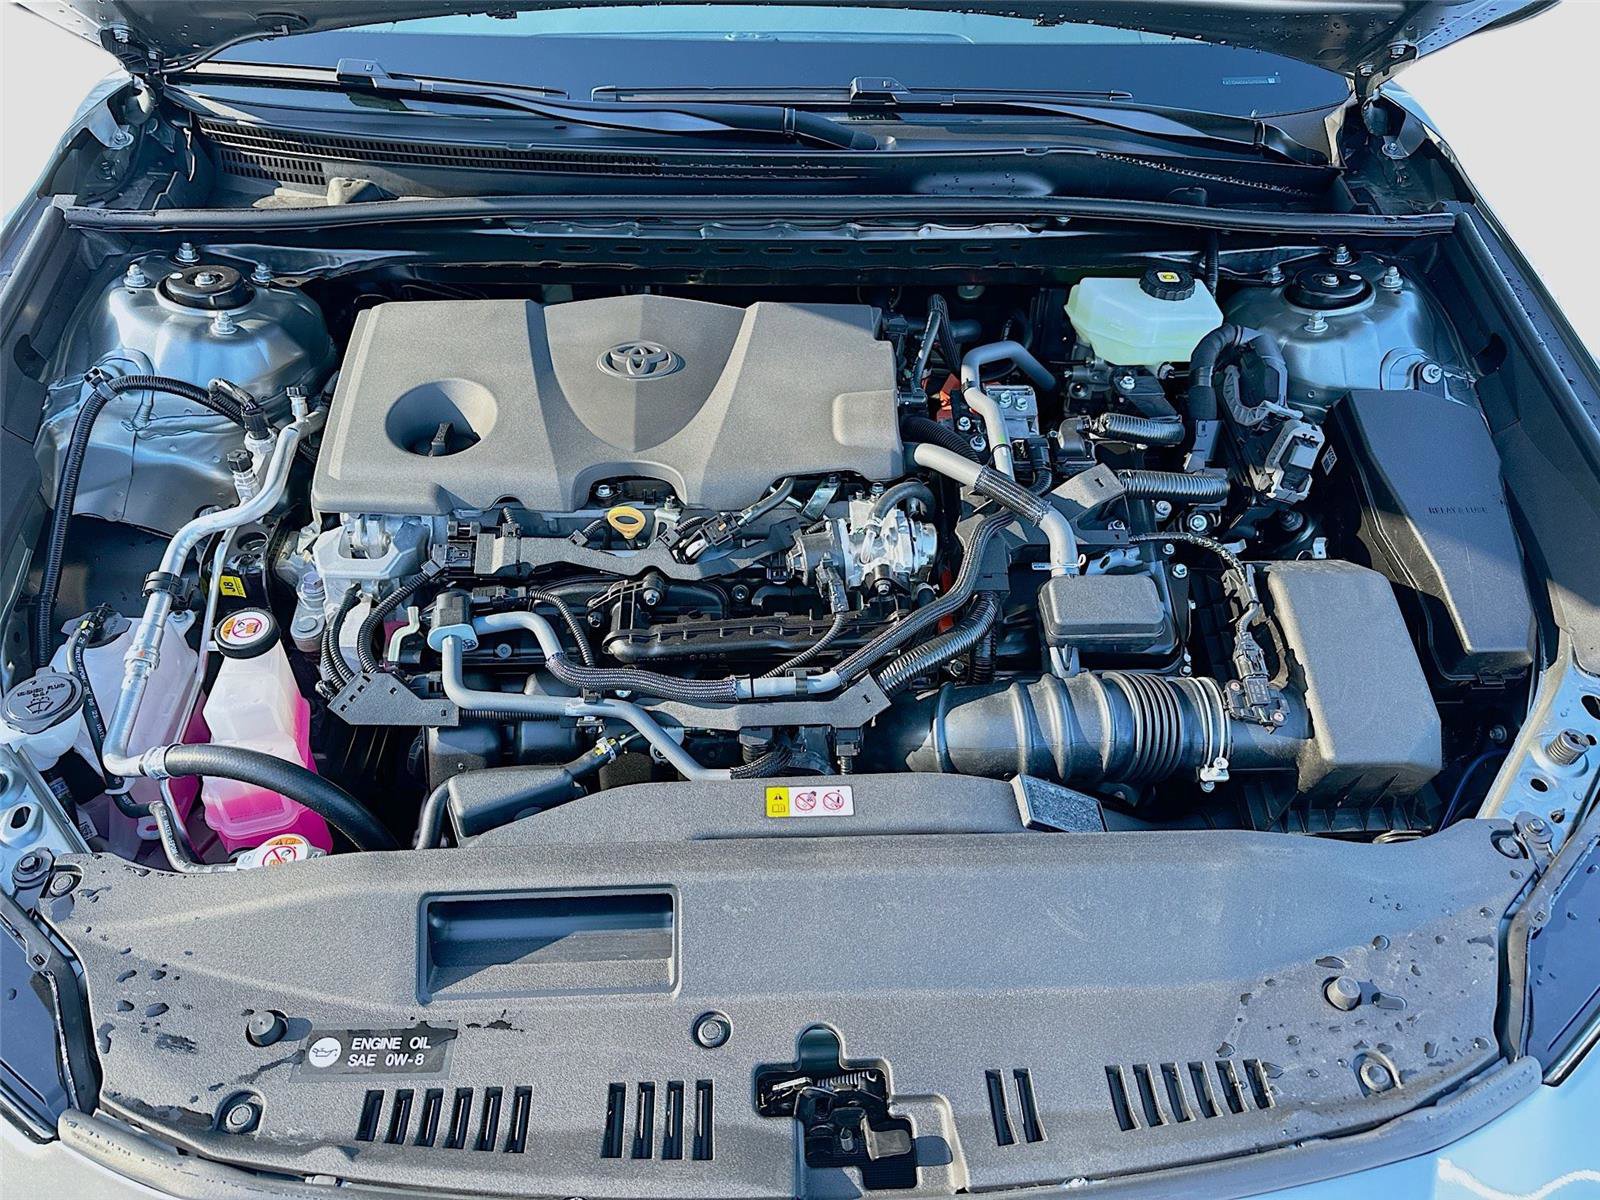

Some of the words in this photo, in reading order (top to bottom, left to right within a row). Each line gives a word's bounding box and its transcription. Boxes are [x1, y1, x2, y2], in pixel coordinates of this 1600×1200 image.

[351, 1037, 402, 1050] ENGINE
[409, 1036, 431, 1050] OIL
[347, 1053, 377, 1067] SAE
[385, 1053, 425, 1067] 0W-8
